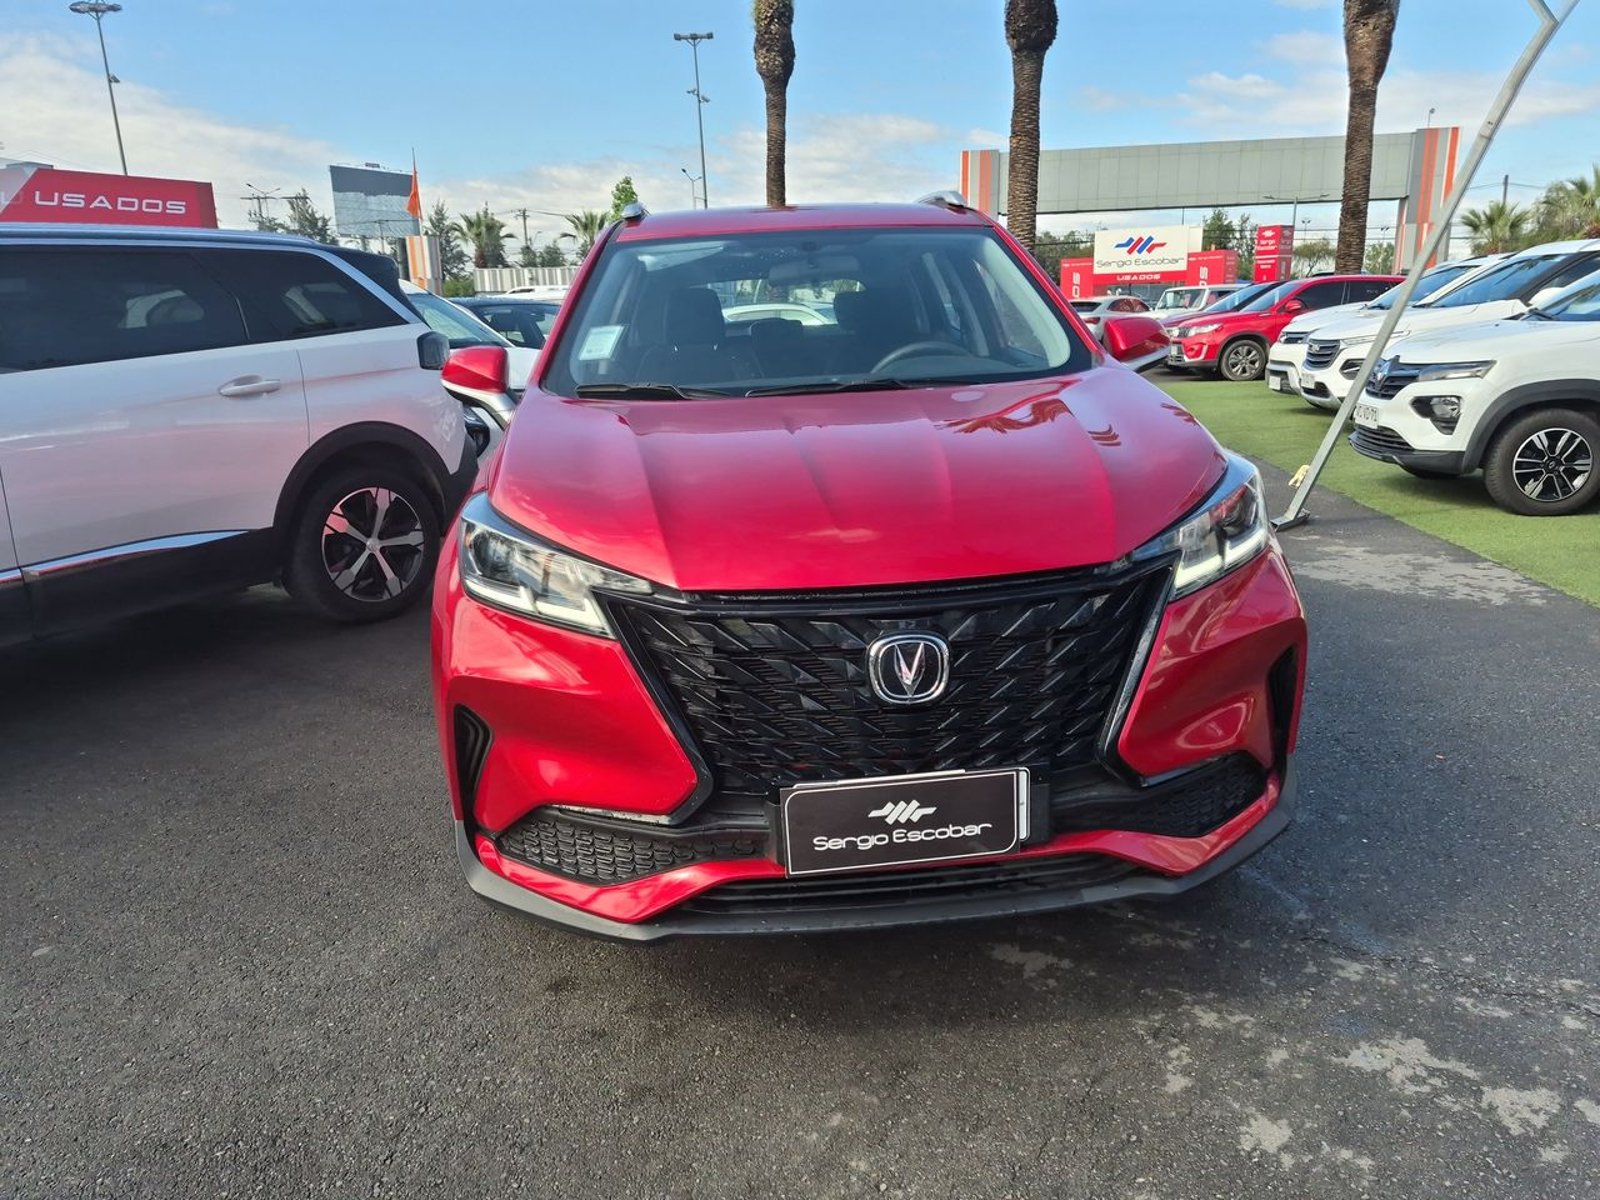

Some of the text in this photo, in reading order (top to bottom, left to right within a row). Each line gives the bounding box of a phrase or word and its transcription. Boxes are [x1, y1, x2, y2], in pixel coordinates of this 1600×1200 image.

[34, 190, 187, 215] USADOS
[1134, 257, 1184, 266] Escobar
[812, 822, 993, 851] Sergio Escobar
